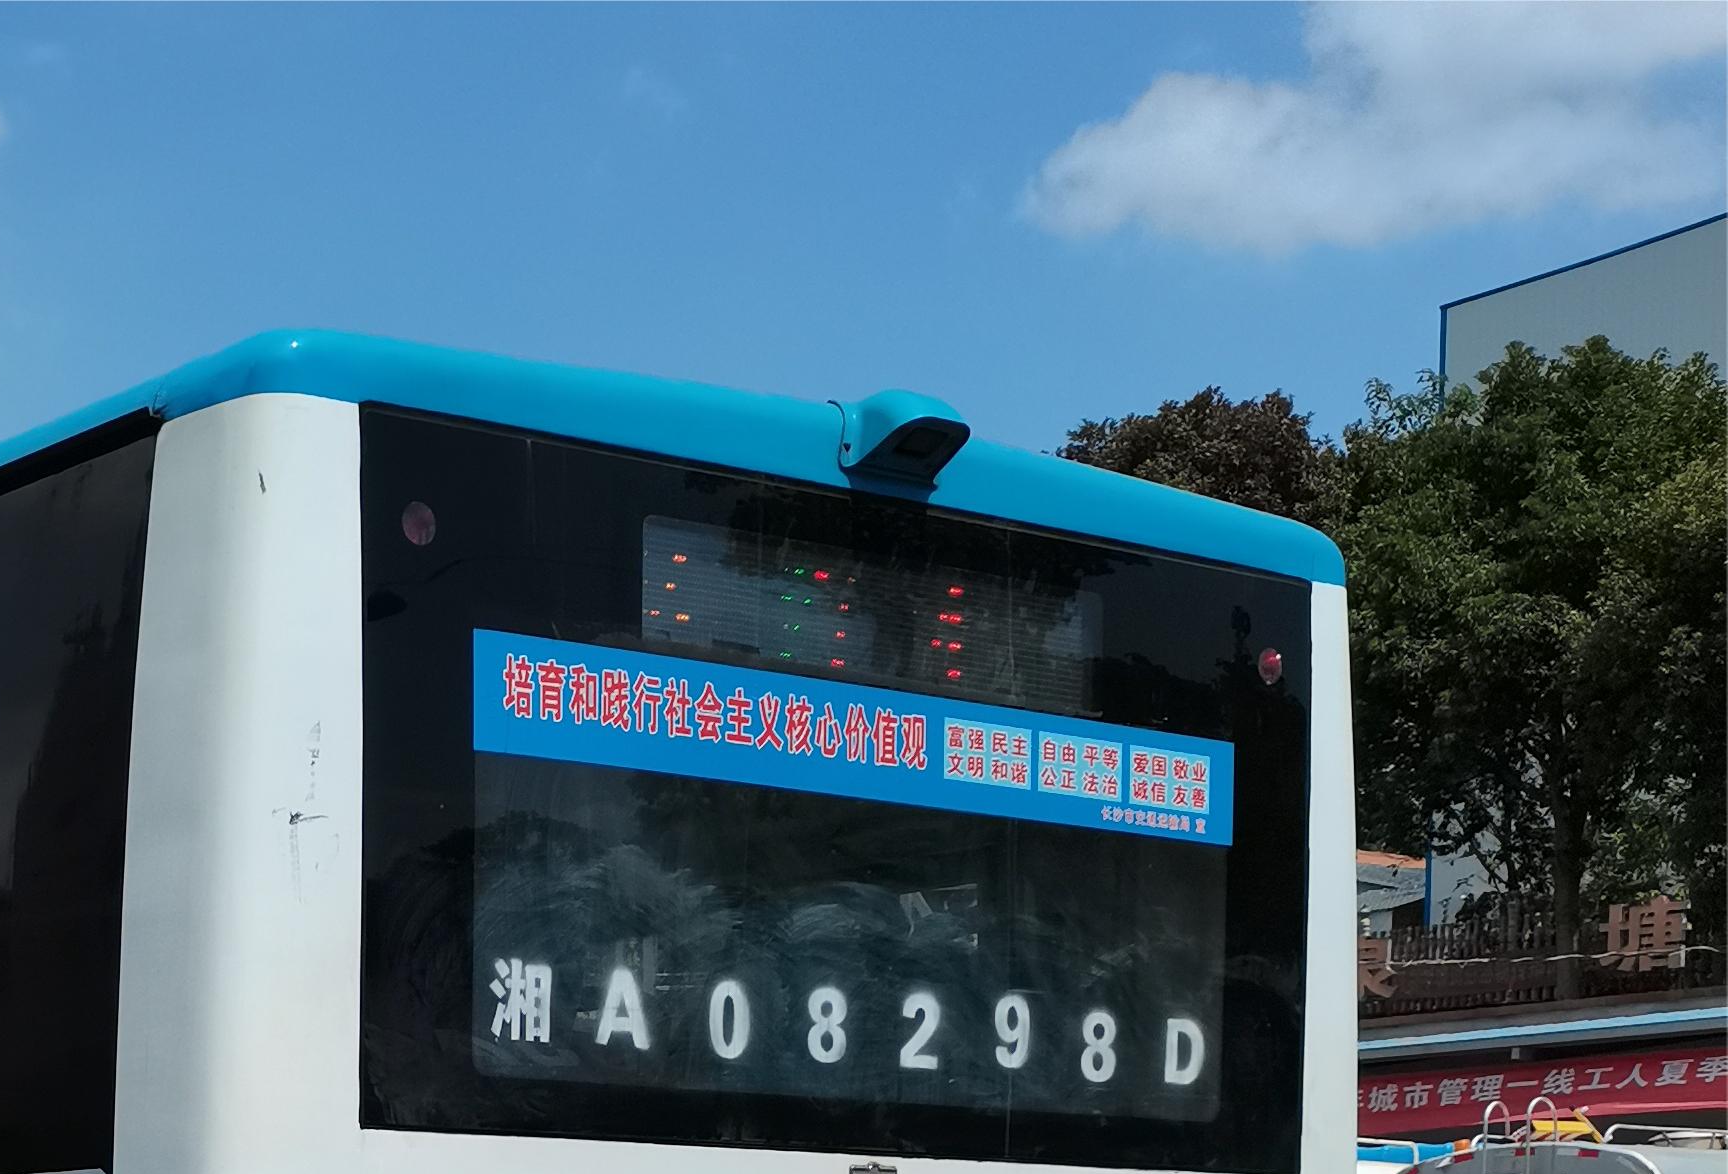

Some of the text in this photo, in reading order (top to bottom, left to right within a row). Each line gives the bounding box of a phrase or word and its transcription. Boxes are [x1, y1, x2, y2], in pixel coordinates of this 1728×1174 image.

[502, 652, 929, 771] 培育和践行社会主义核心价值观
[947, 725, 1029, 757] 富强 民主
[1041, 739, 1119, 770] 自由 平等
[947, 754, 1028, 785] 文明 和谐
[1040, 767, 1118, 796] 公正 法治
[1133, 752, 1207, 783] 爱国 敬业
[1132, 778, 1206, 808] 诚信 友善
[1357, 1055, 1728, 1113] 城市管理一线工人夏季
